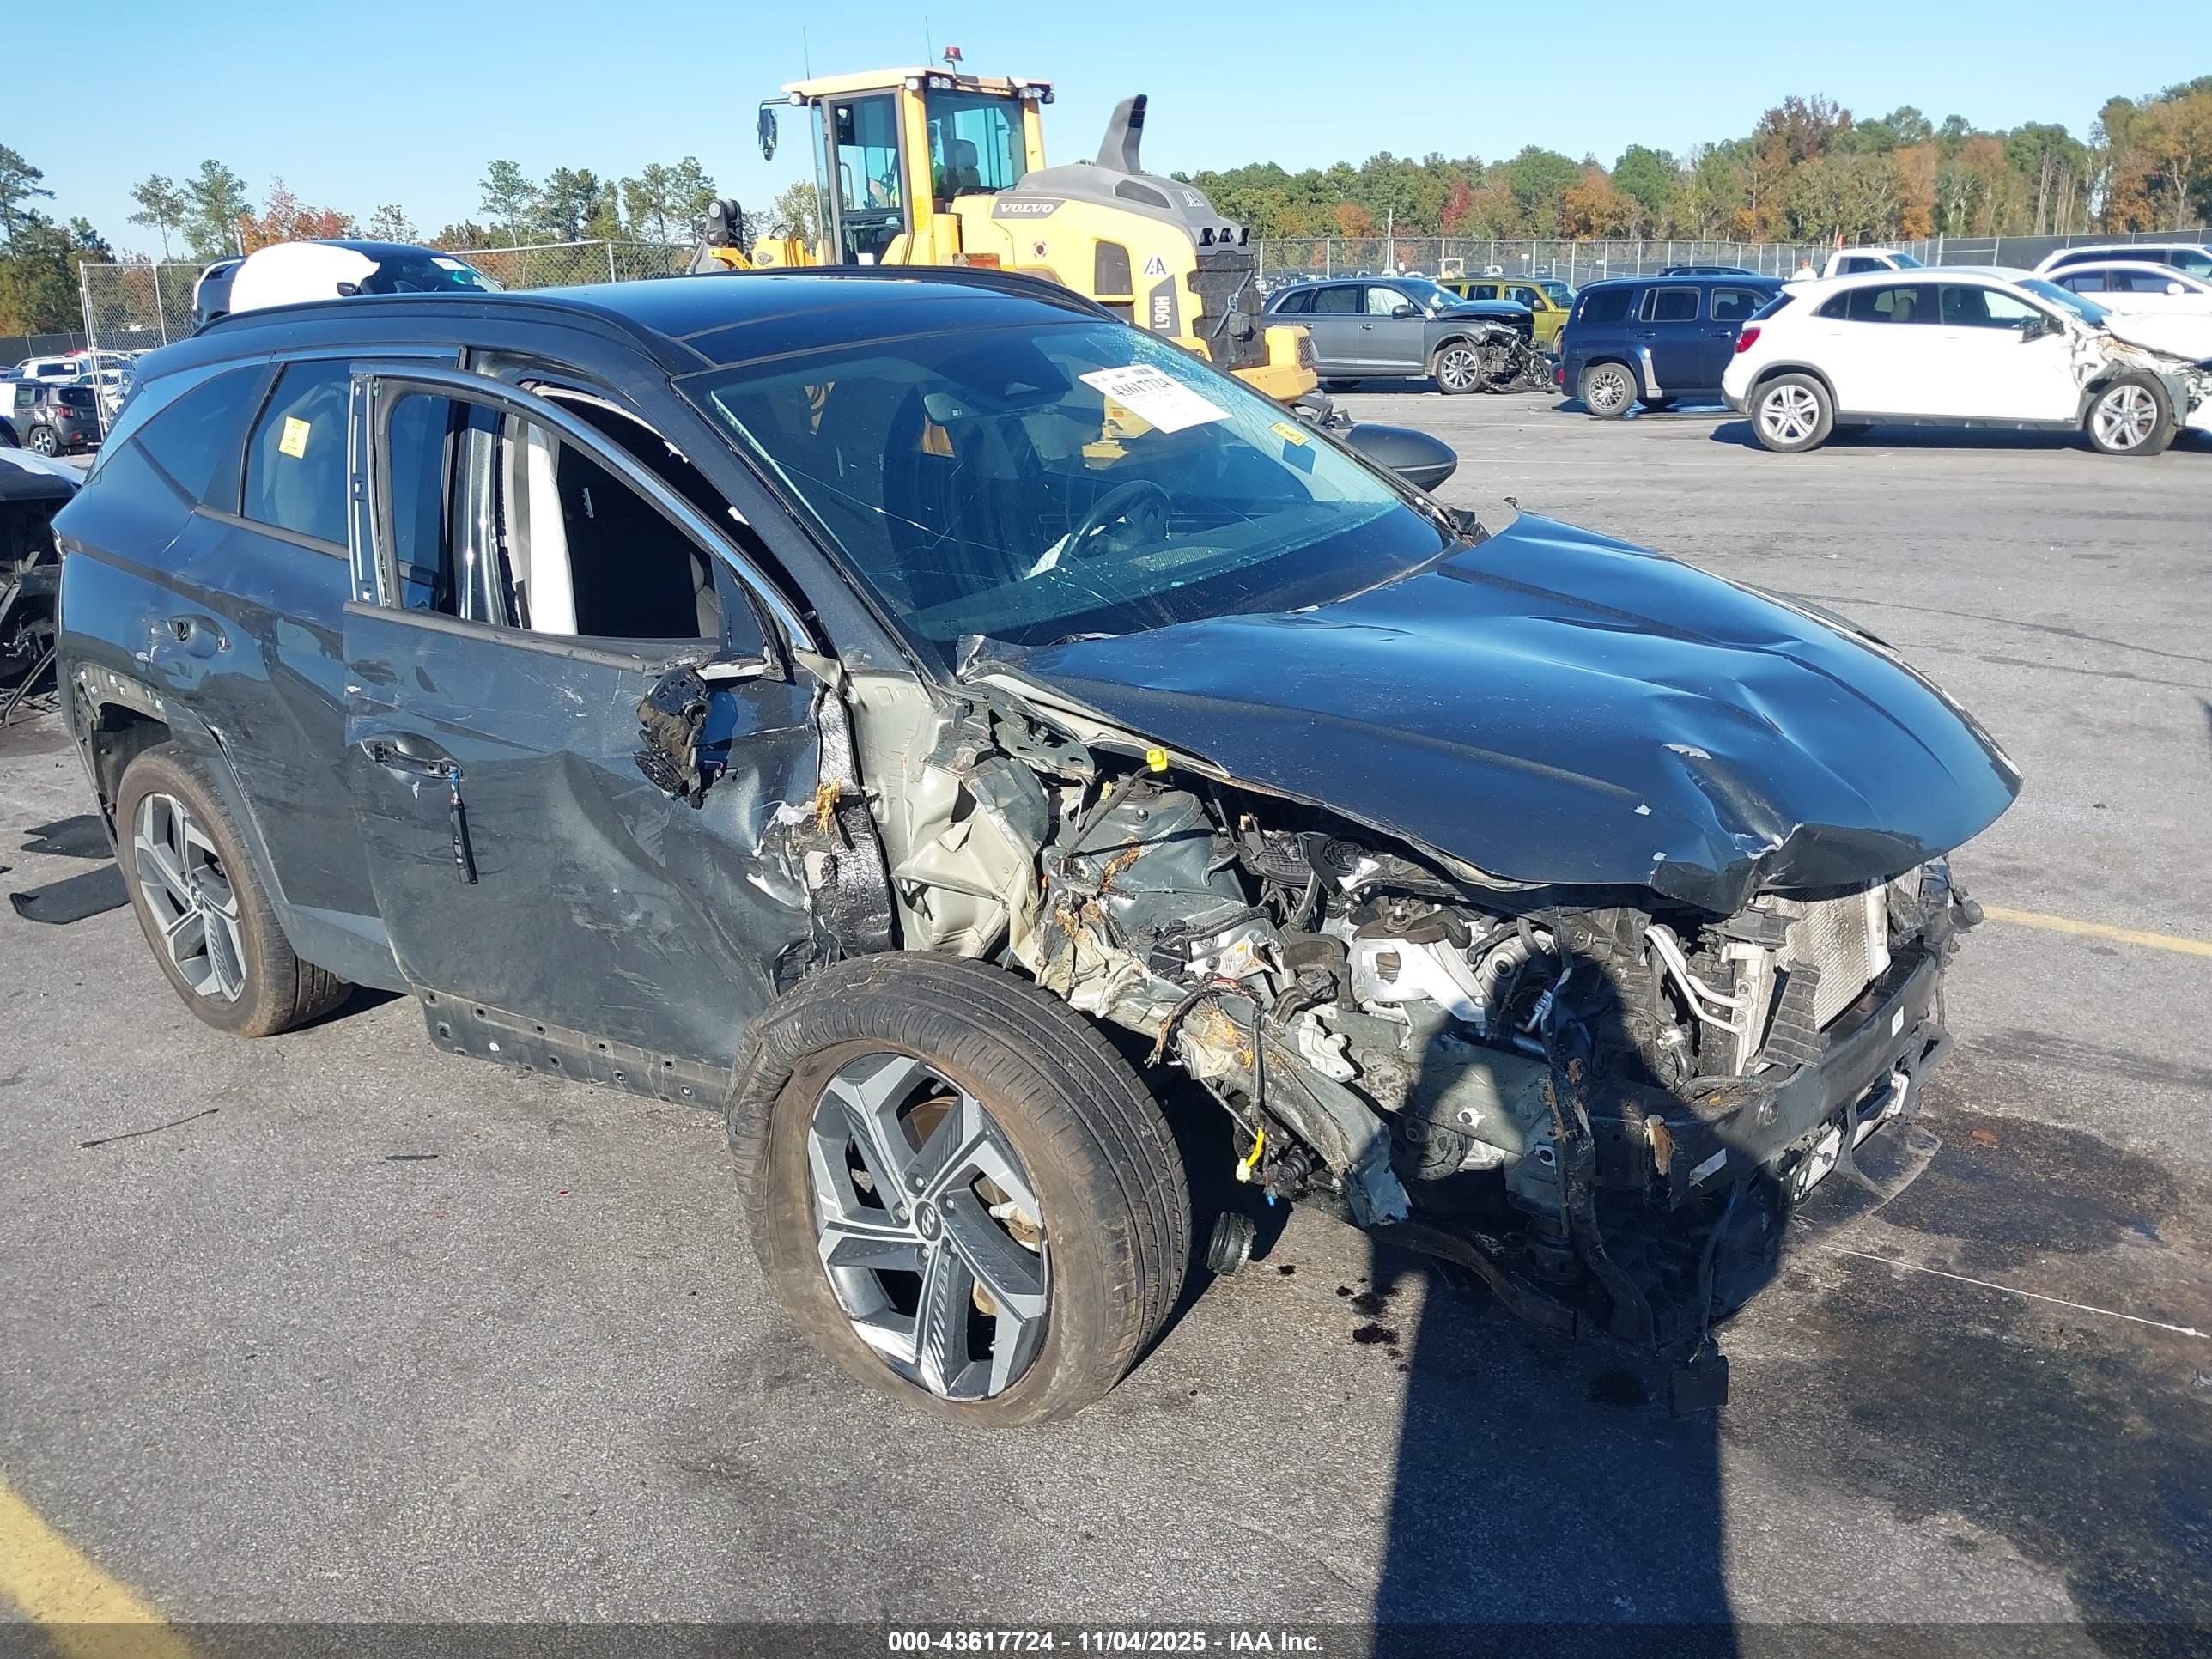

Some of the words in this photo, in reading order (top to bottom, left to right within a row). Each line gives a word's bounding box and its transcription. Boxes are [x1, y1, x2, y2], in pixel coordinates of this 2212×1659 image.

[1000, 203, 1055, 214] VOLVO
[1153, 295, 1170, 329] L90H
[1112, 377, 1174, 397] 43617724
